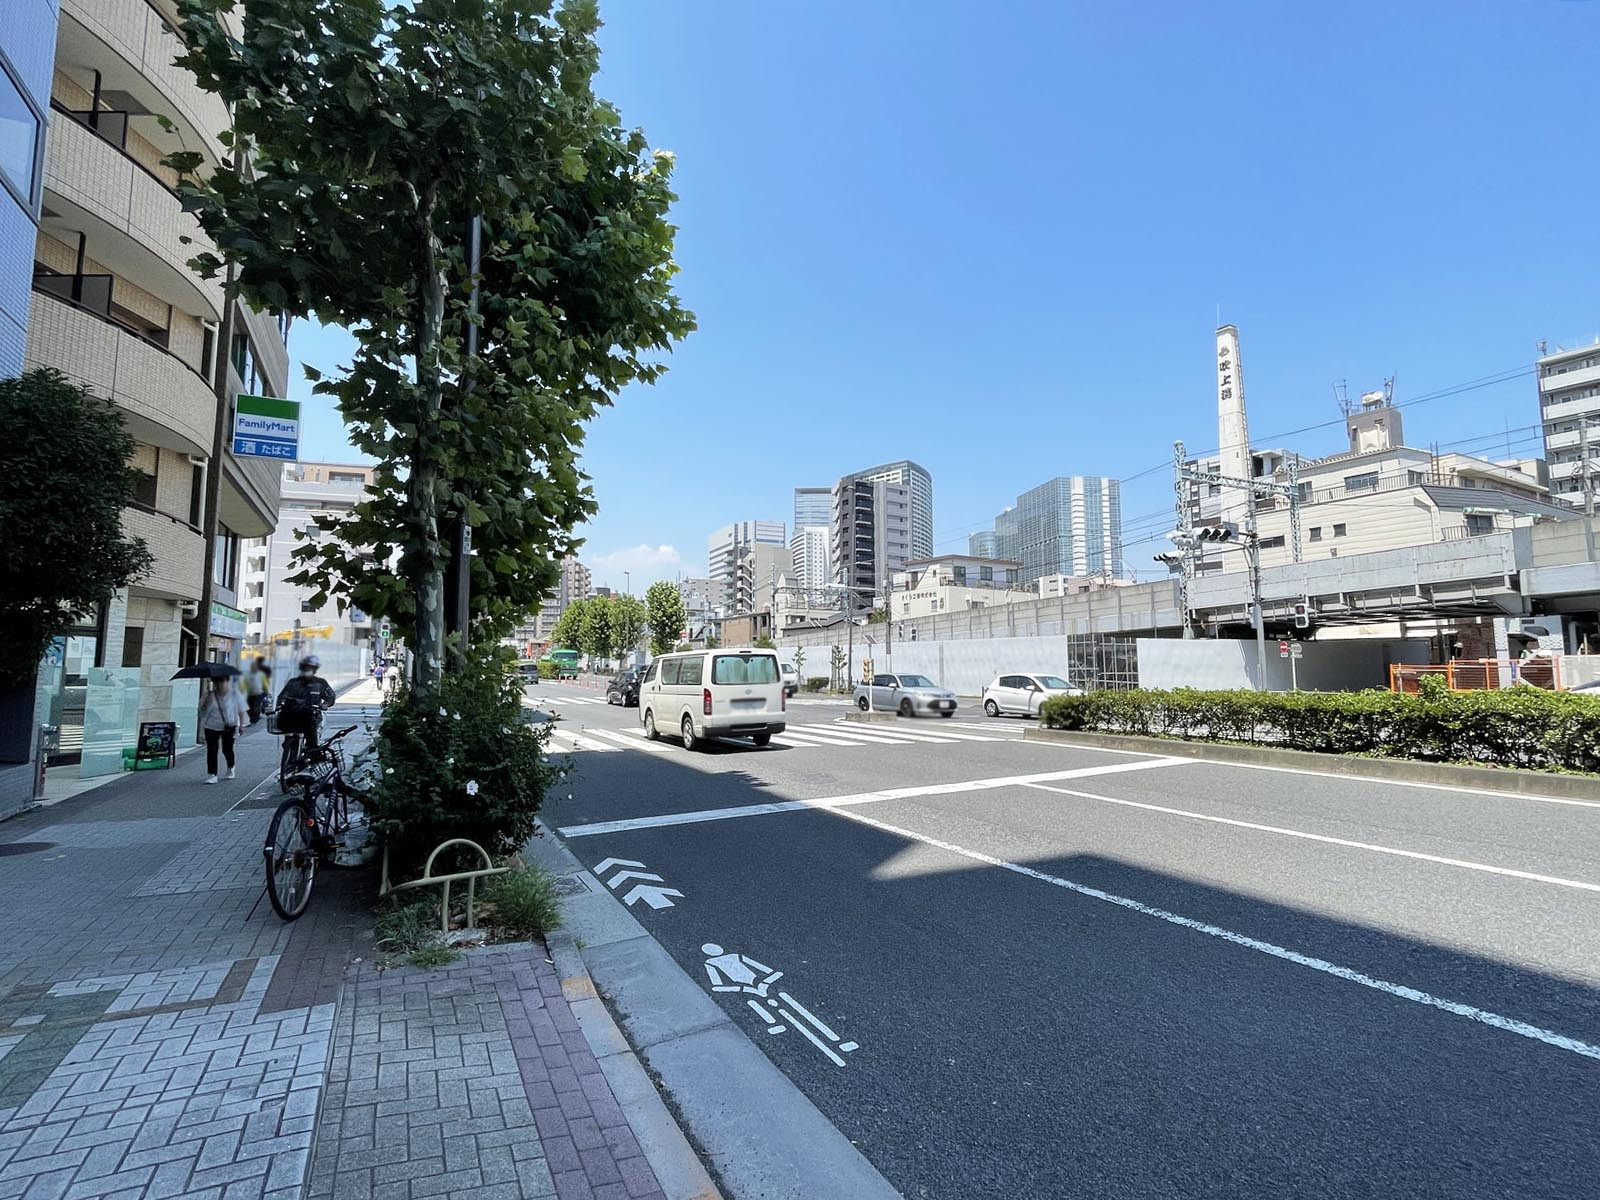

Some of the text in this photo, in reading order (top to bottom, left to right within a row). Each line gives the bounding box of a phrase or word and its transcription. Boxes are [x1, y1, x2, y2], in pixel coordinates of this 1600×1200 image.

[238, 418, 295, 433] FamilyMart
[241, 441, 291, 456] 酒 たばこ
